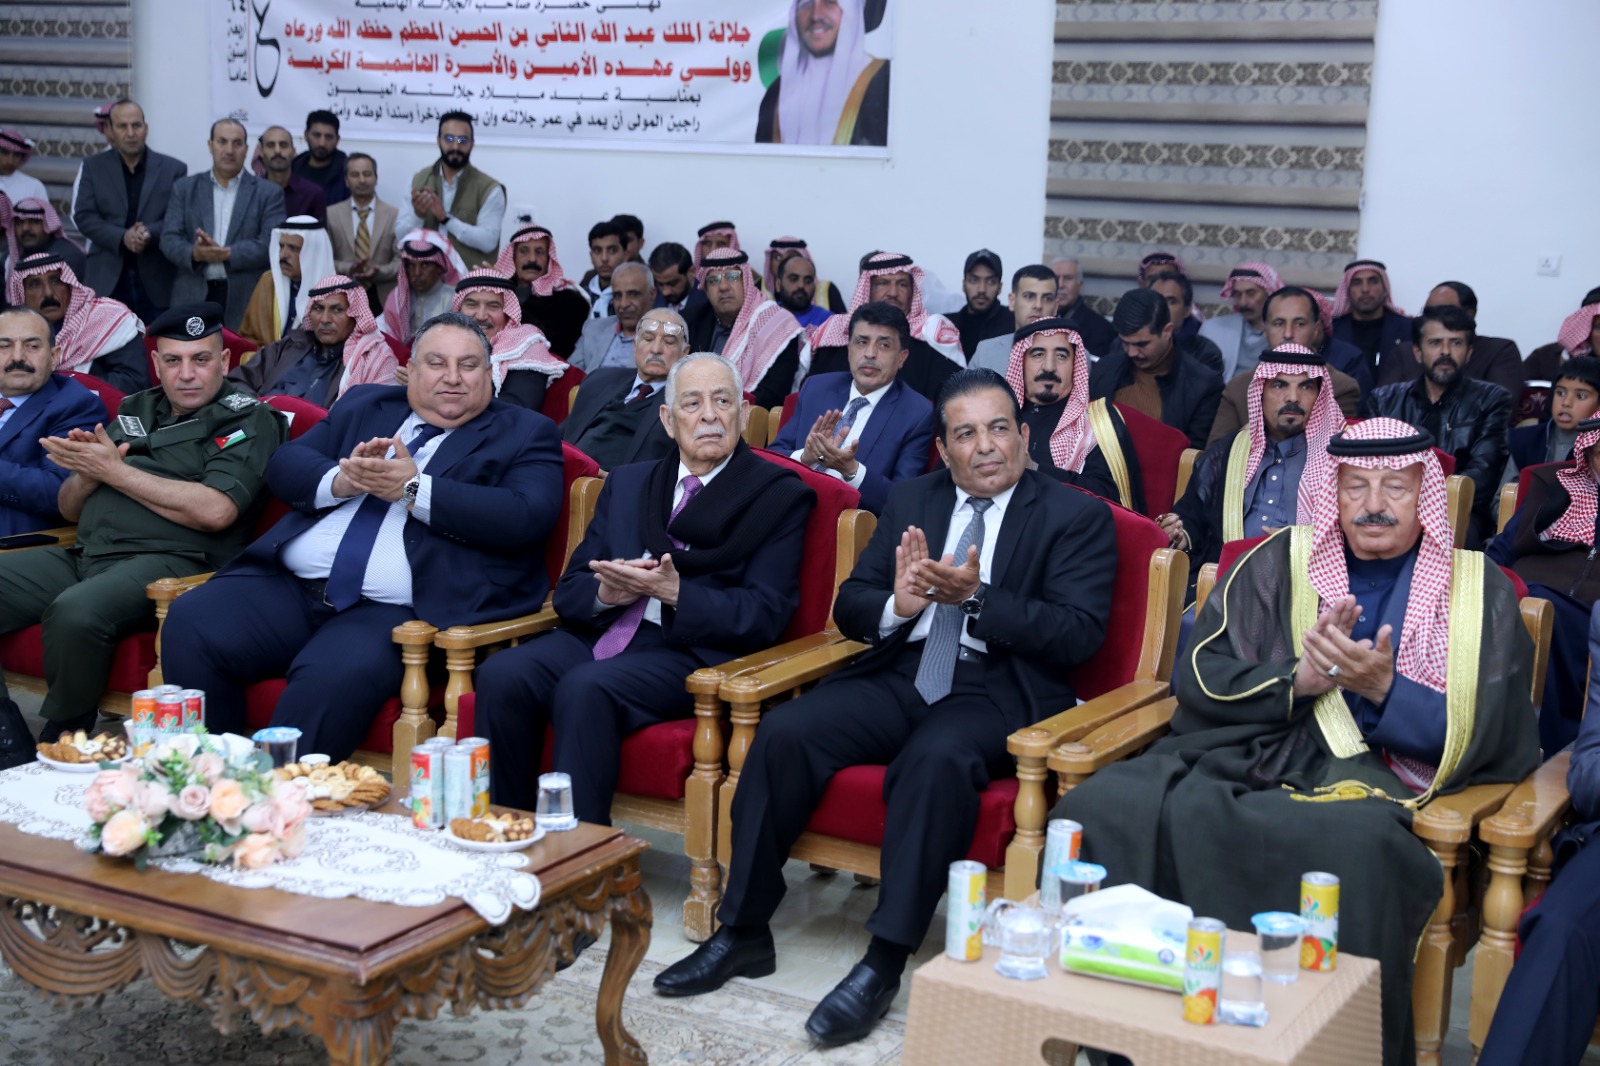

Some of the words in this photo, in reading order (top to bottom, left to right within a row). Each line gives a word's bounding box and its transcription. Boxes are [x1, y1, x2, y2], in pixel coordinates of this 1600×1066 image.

[284, 18, 322, 43] ورعاه
[327, 17, 350, 38] الله
[356, 19, 392, 39] حفظه
[400, 20, 444, 46] المعظم
[450, 22, 502, 48] الحسين
[509, 26, 528, 47] بن
[535, 21, 585, 52] الثاني
[591, 20, 618, 42] الله
[624, 26, 655, 48] عبد
[662, 21, 701, 43] الملك
[709, 21, 751, 47] جلالة
[287, 47, 350, 74] الكريمة
[356, 50, 438, 76] الهاشمية
[445, 48, 517, 79] والأسرة
[523, 50, 597, 81] الأمين
[604, 59, 673, 76] عهده
[680, 56, 752, 85] وولي
[327, 82, 397, 98] الميمون
[401, 83, 473, 101] جلالته
[479, 84, 545, 103] ميلاد
[550, 89, 608, 104] عيد
[615, 87, 701, 106] بمناسبة
[354, 104, 382, 122] لوطنه
[502, 109, 536, 128] جلالته
[541, 115, 562, 128] عمر
[567, 111, 582, 132] في
[587, 115, 607, 130] يمد
[612, 110, 623, 131] أن
[628, 114, 662, 131] المولى
[667, 112, 700, 132] راجين
